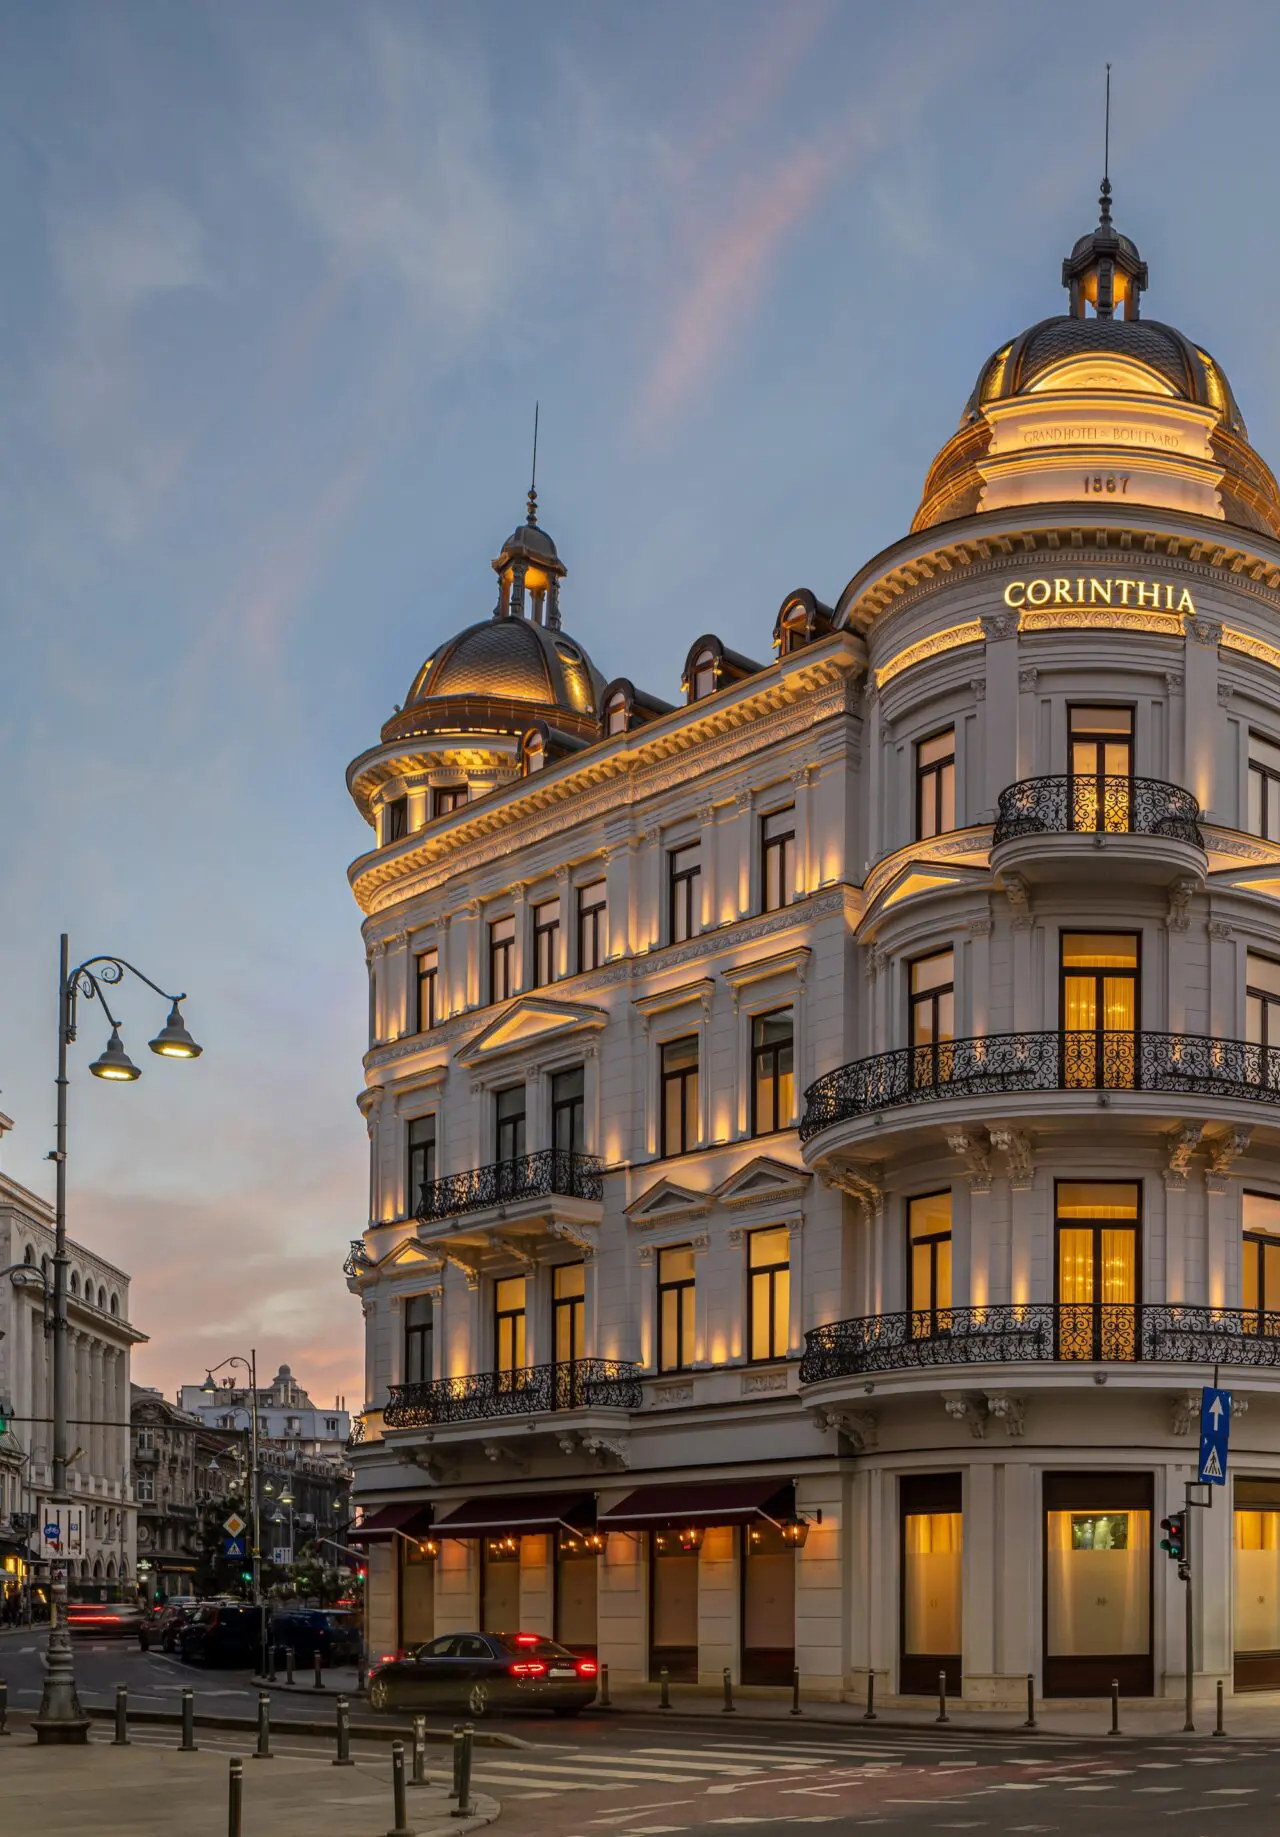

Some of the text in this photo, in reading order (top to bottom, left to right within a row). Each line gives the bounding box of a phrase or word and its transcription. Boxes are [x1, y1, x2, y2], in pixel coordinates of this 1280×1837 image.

[1023, 428, 1062, 444] GRAND
[1064, 427, 1098, 441] HOTEL
[1113, 427, 1179, 448] BOULEVARD
[1084, 475, 1130, 494] 1867
[1004, 578, 1197, 615] CORINTHIA
